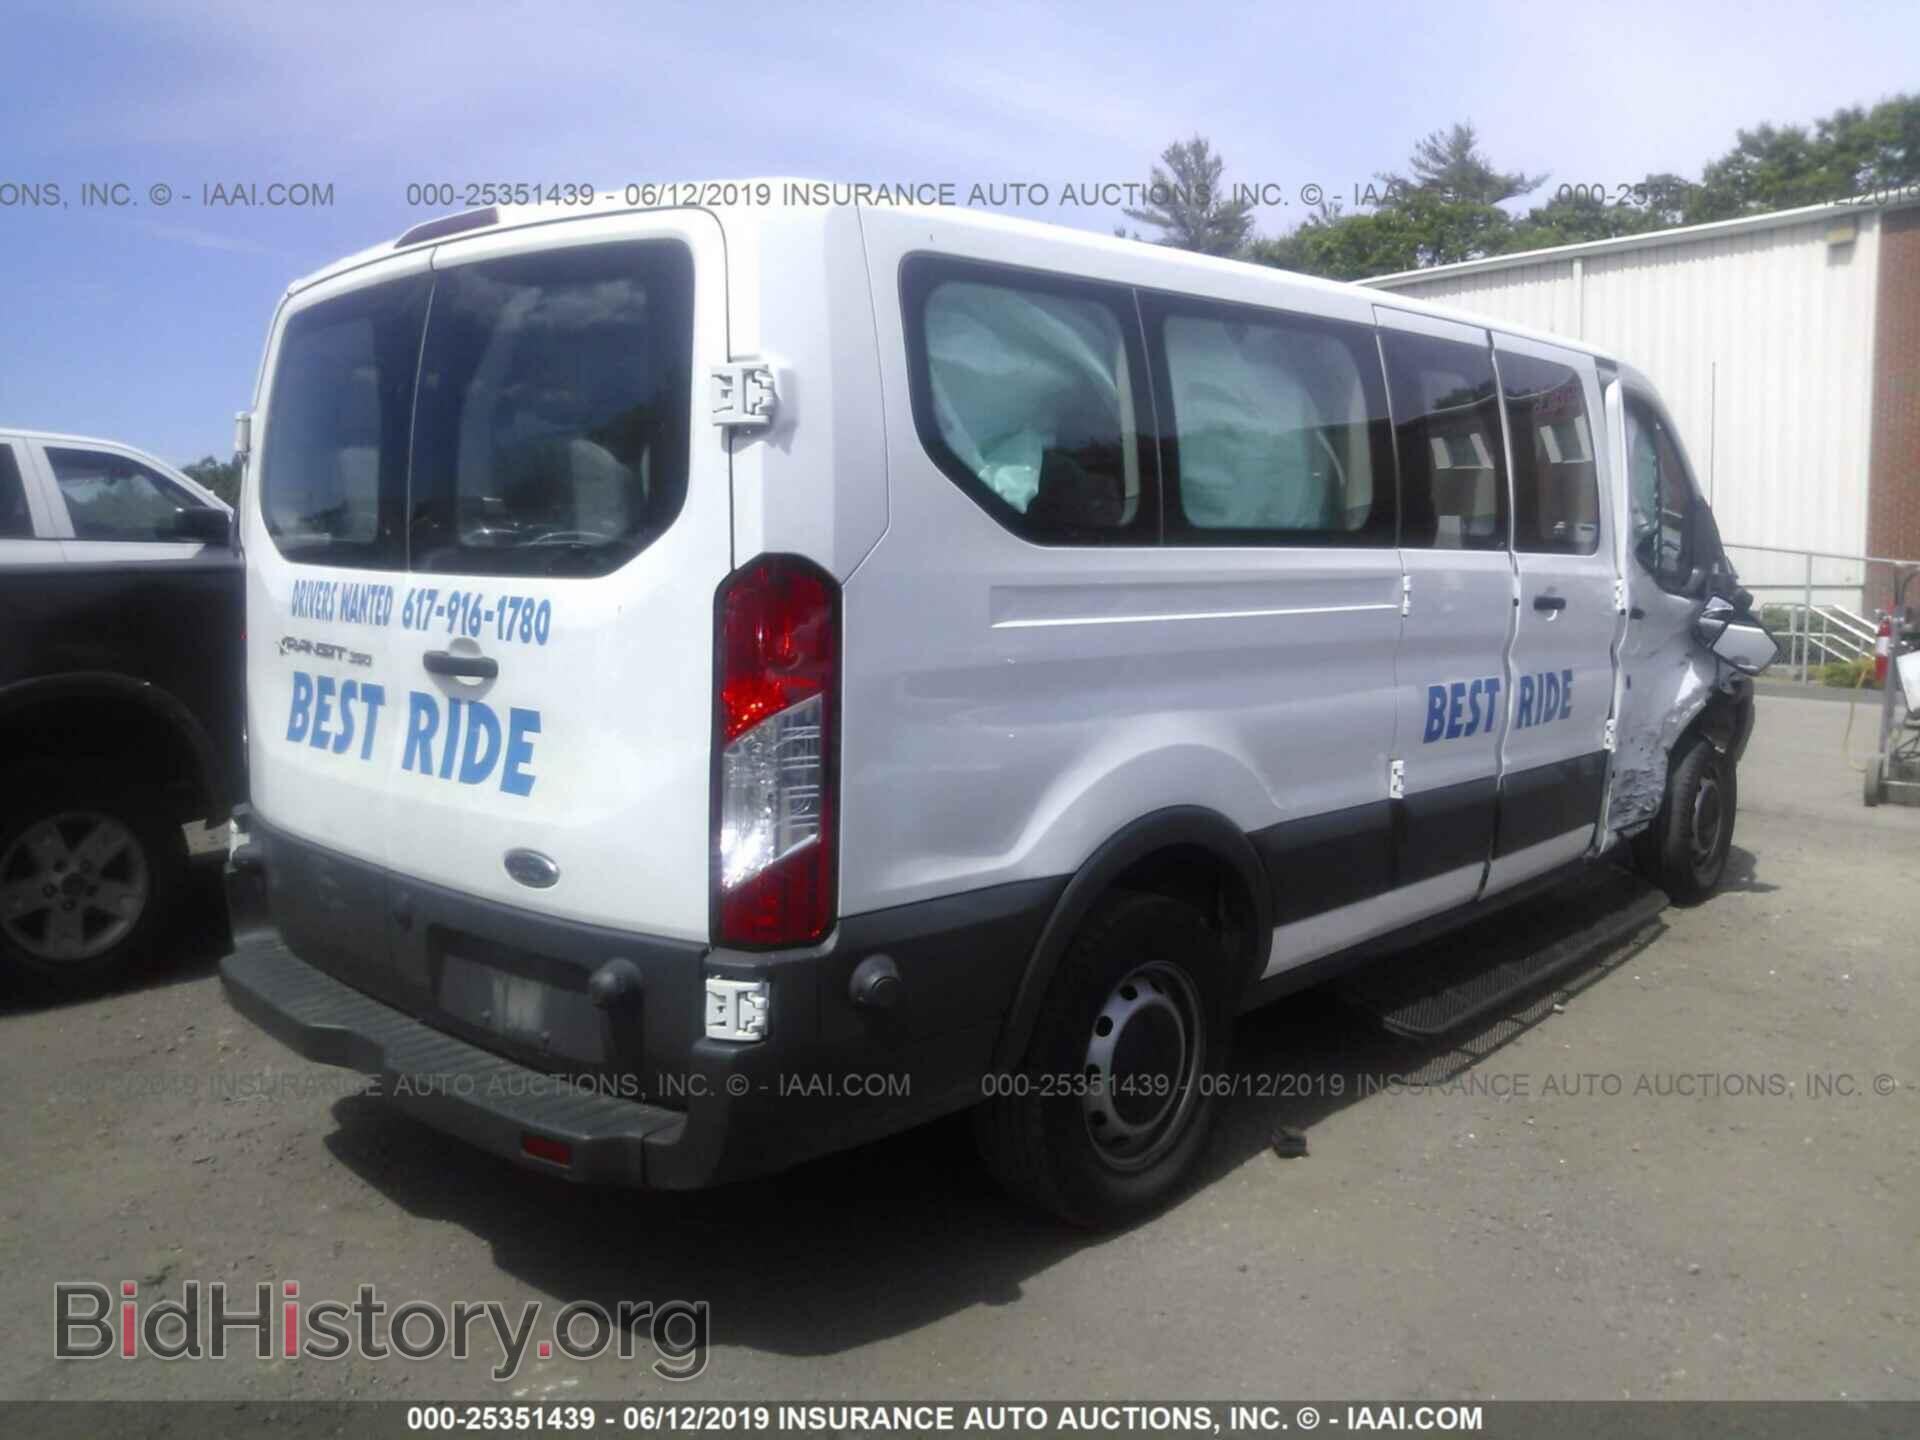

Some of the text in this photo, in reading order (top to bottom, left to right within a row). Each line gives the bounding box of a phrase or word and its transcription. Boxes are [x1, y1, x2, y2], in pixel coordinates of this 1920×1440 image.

[290, 579, 552, 646] DRIVERS WANTED 617-916-1780
[285, 670, 542, 797] BEST RIDE
[1422, 669, 1573, 744] BEST RIDE
